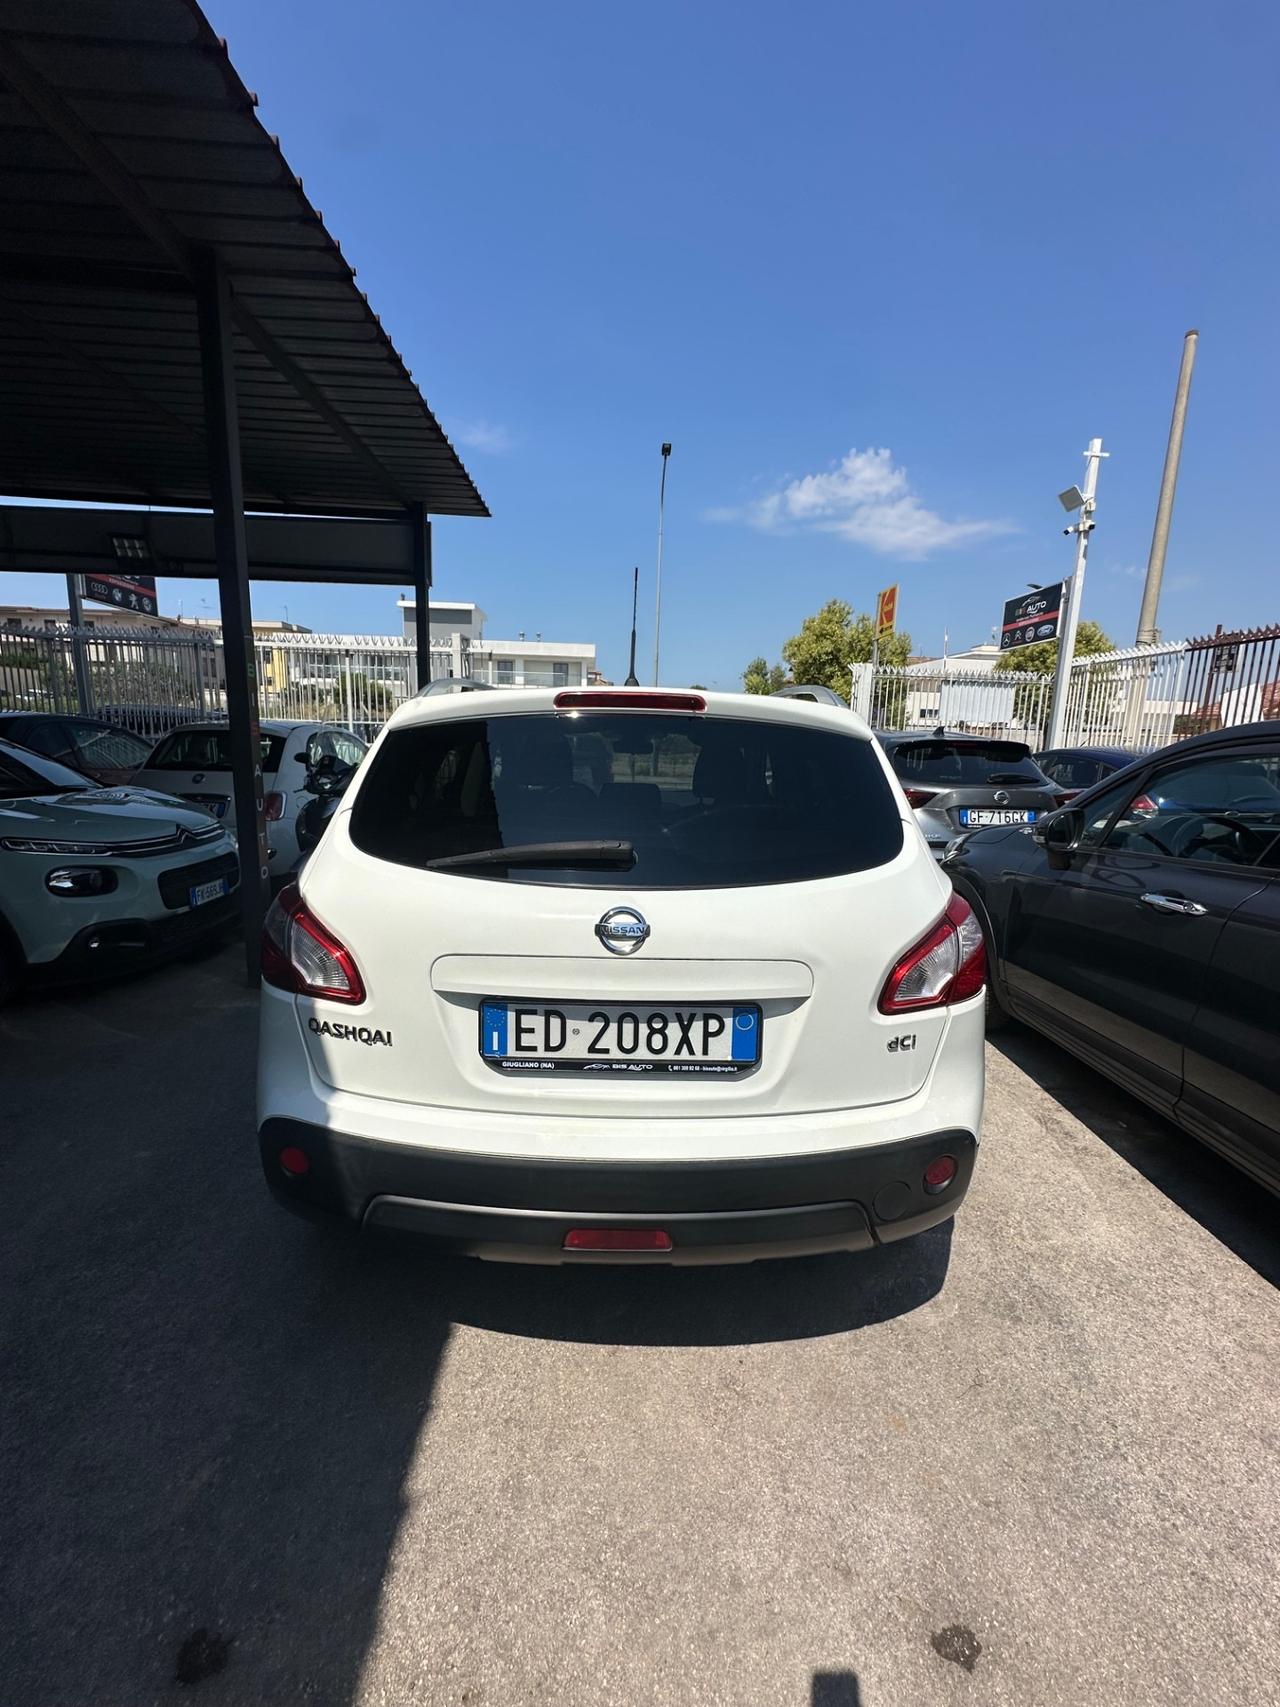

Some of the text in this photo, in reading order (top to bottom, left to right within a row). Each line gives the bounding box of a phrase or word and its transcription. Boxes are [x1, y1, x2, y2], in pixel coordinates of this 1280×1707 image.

[1027, 601, 1047, 613] AUTO
[255, 764, 269, 879] AUTO
[969, 810, 984, 823] GF
[989, 810, 1026, 823] 716GK
[601, 926, 645, 936] NISSAN
[308, 1017, 393, 1046] QASHQAI
[515, 1008, 567, 1052] ED
[587, 1011, 725, 1056] 208XP
